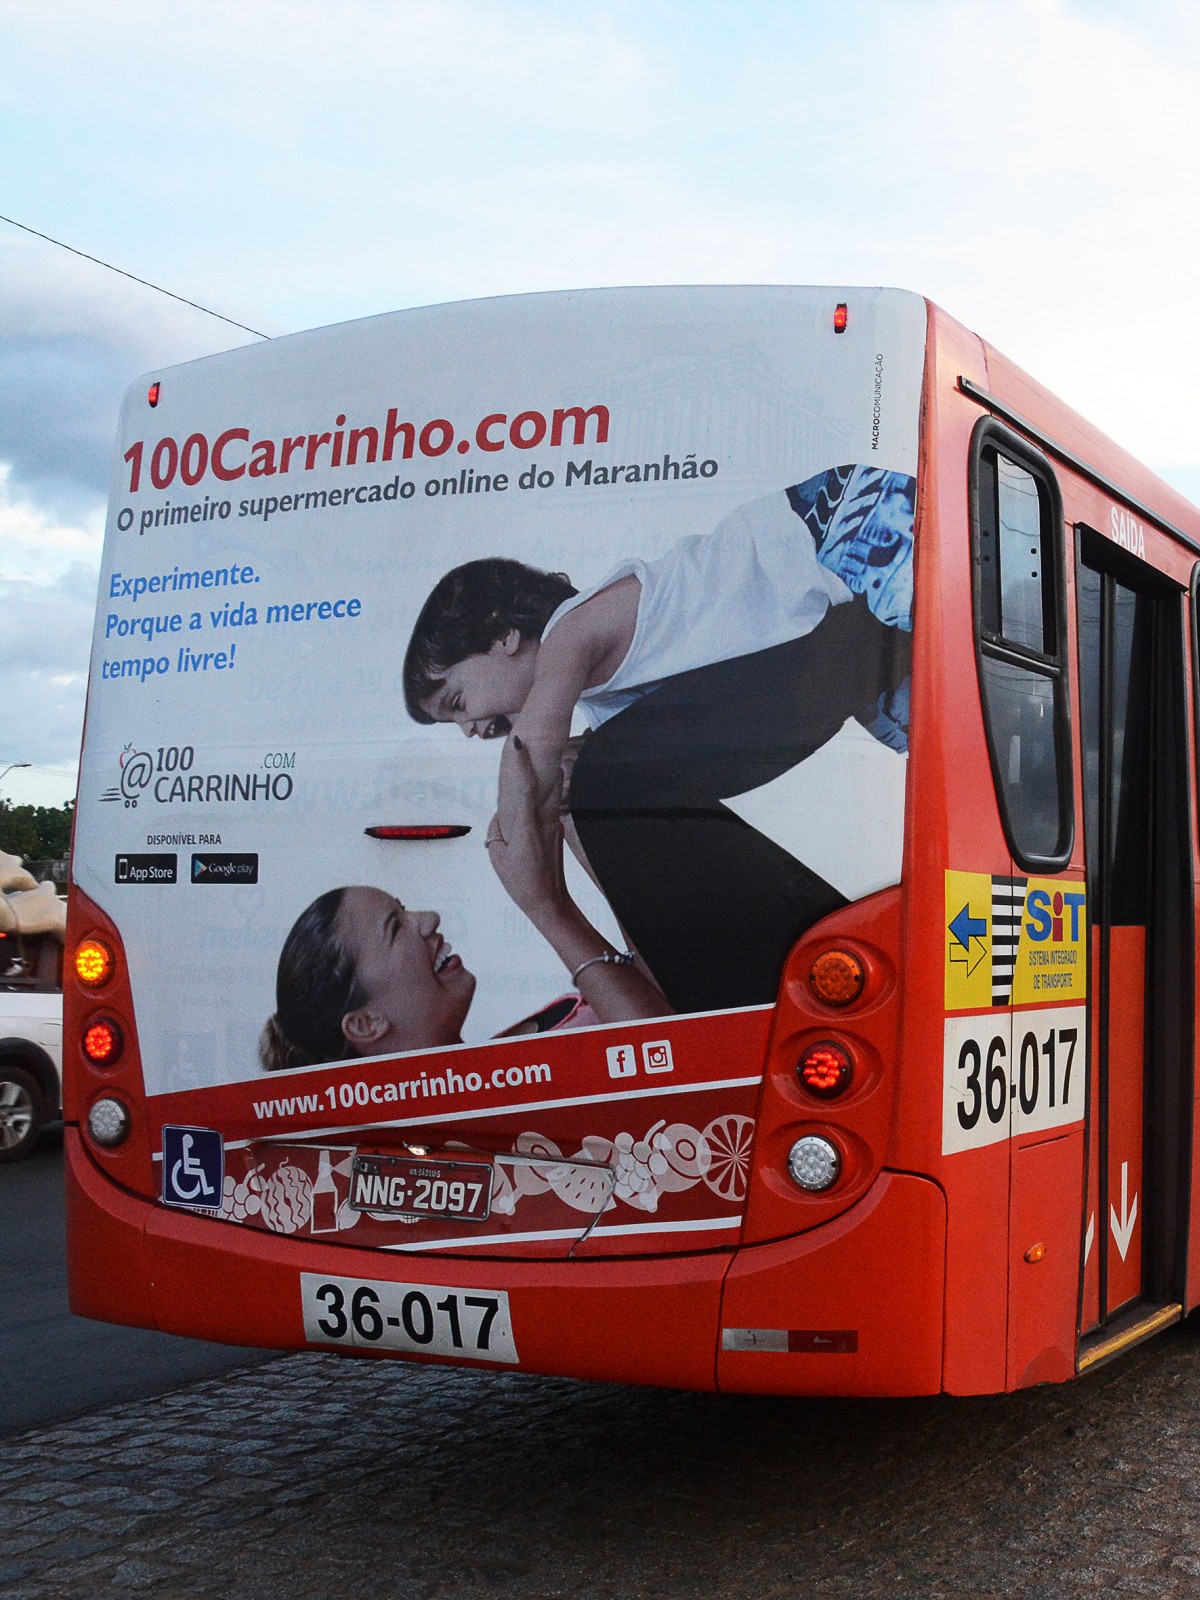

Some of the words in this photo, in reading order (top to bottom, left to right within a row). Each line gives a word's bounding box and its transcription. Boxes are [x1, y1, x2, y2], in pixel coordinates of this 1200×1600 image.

[871, 353, 884, 451] MACROCOMUNICAÇÃO
[123, 403, 610, 493] 100Carrinho.com
[116, 507, 134, 532] O
[139, 496, 232, 536] primeiro
[237, 475, 416, 522] supermercado
[423, 468, 509, 497] online
[518, 463, 555, 491] do
[565, 453, 719, 488] Maranhão
[109, 562, 261, 603] Experimente.
[105, 613, 183, 642] Porque
[188, 611, 203, 631] a
[209, 601, 259, 630] vida
[265, 597, 363, 625] merece
[101, 655, 170, 683] tempo
[176, 643, 237, 674] livre!
[153, 772, 294, 804] CARRINHO
[146, 831, 197, 846] DISPONÍVEL
[198, 833, 223, 845] PARA
[129, 866, 149, 881] App
[149, 866, 174, 879] Store
[207, 862, 237, 877] Google
[237, 864, 254, 876] play
[1028, 949, 1050, 966] SISTEMA
[1033, 973, 1041, 989] DE
[252, 1061, 553, 1120] www.100carrinho.com
[956, 1027, 1078, 1131] 36-017
[314, 1283, 501, 1351] 36-017
